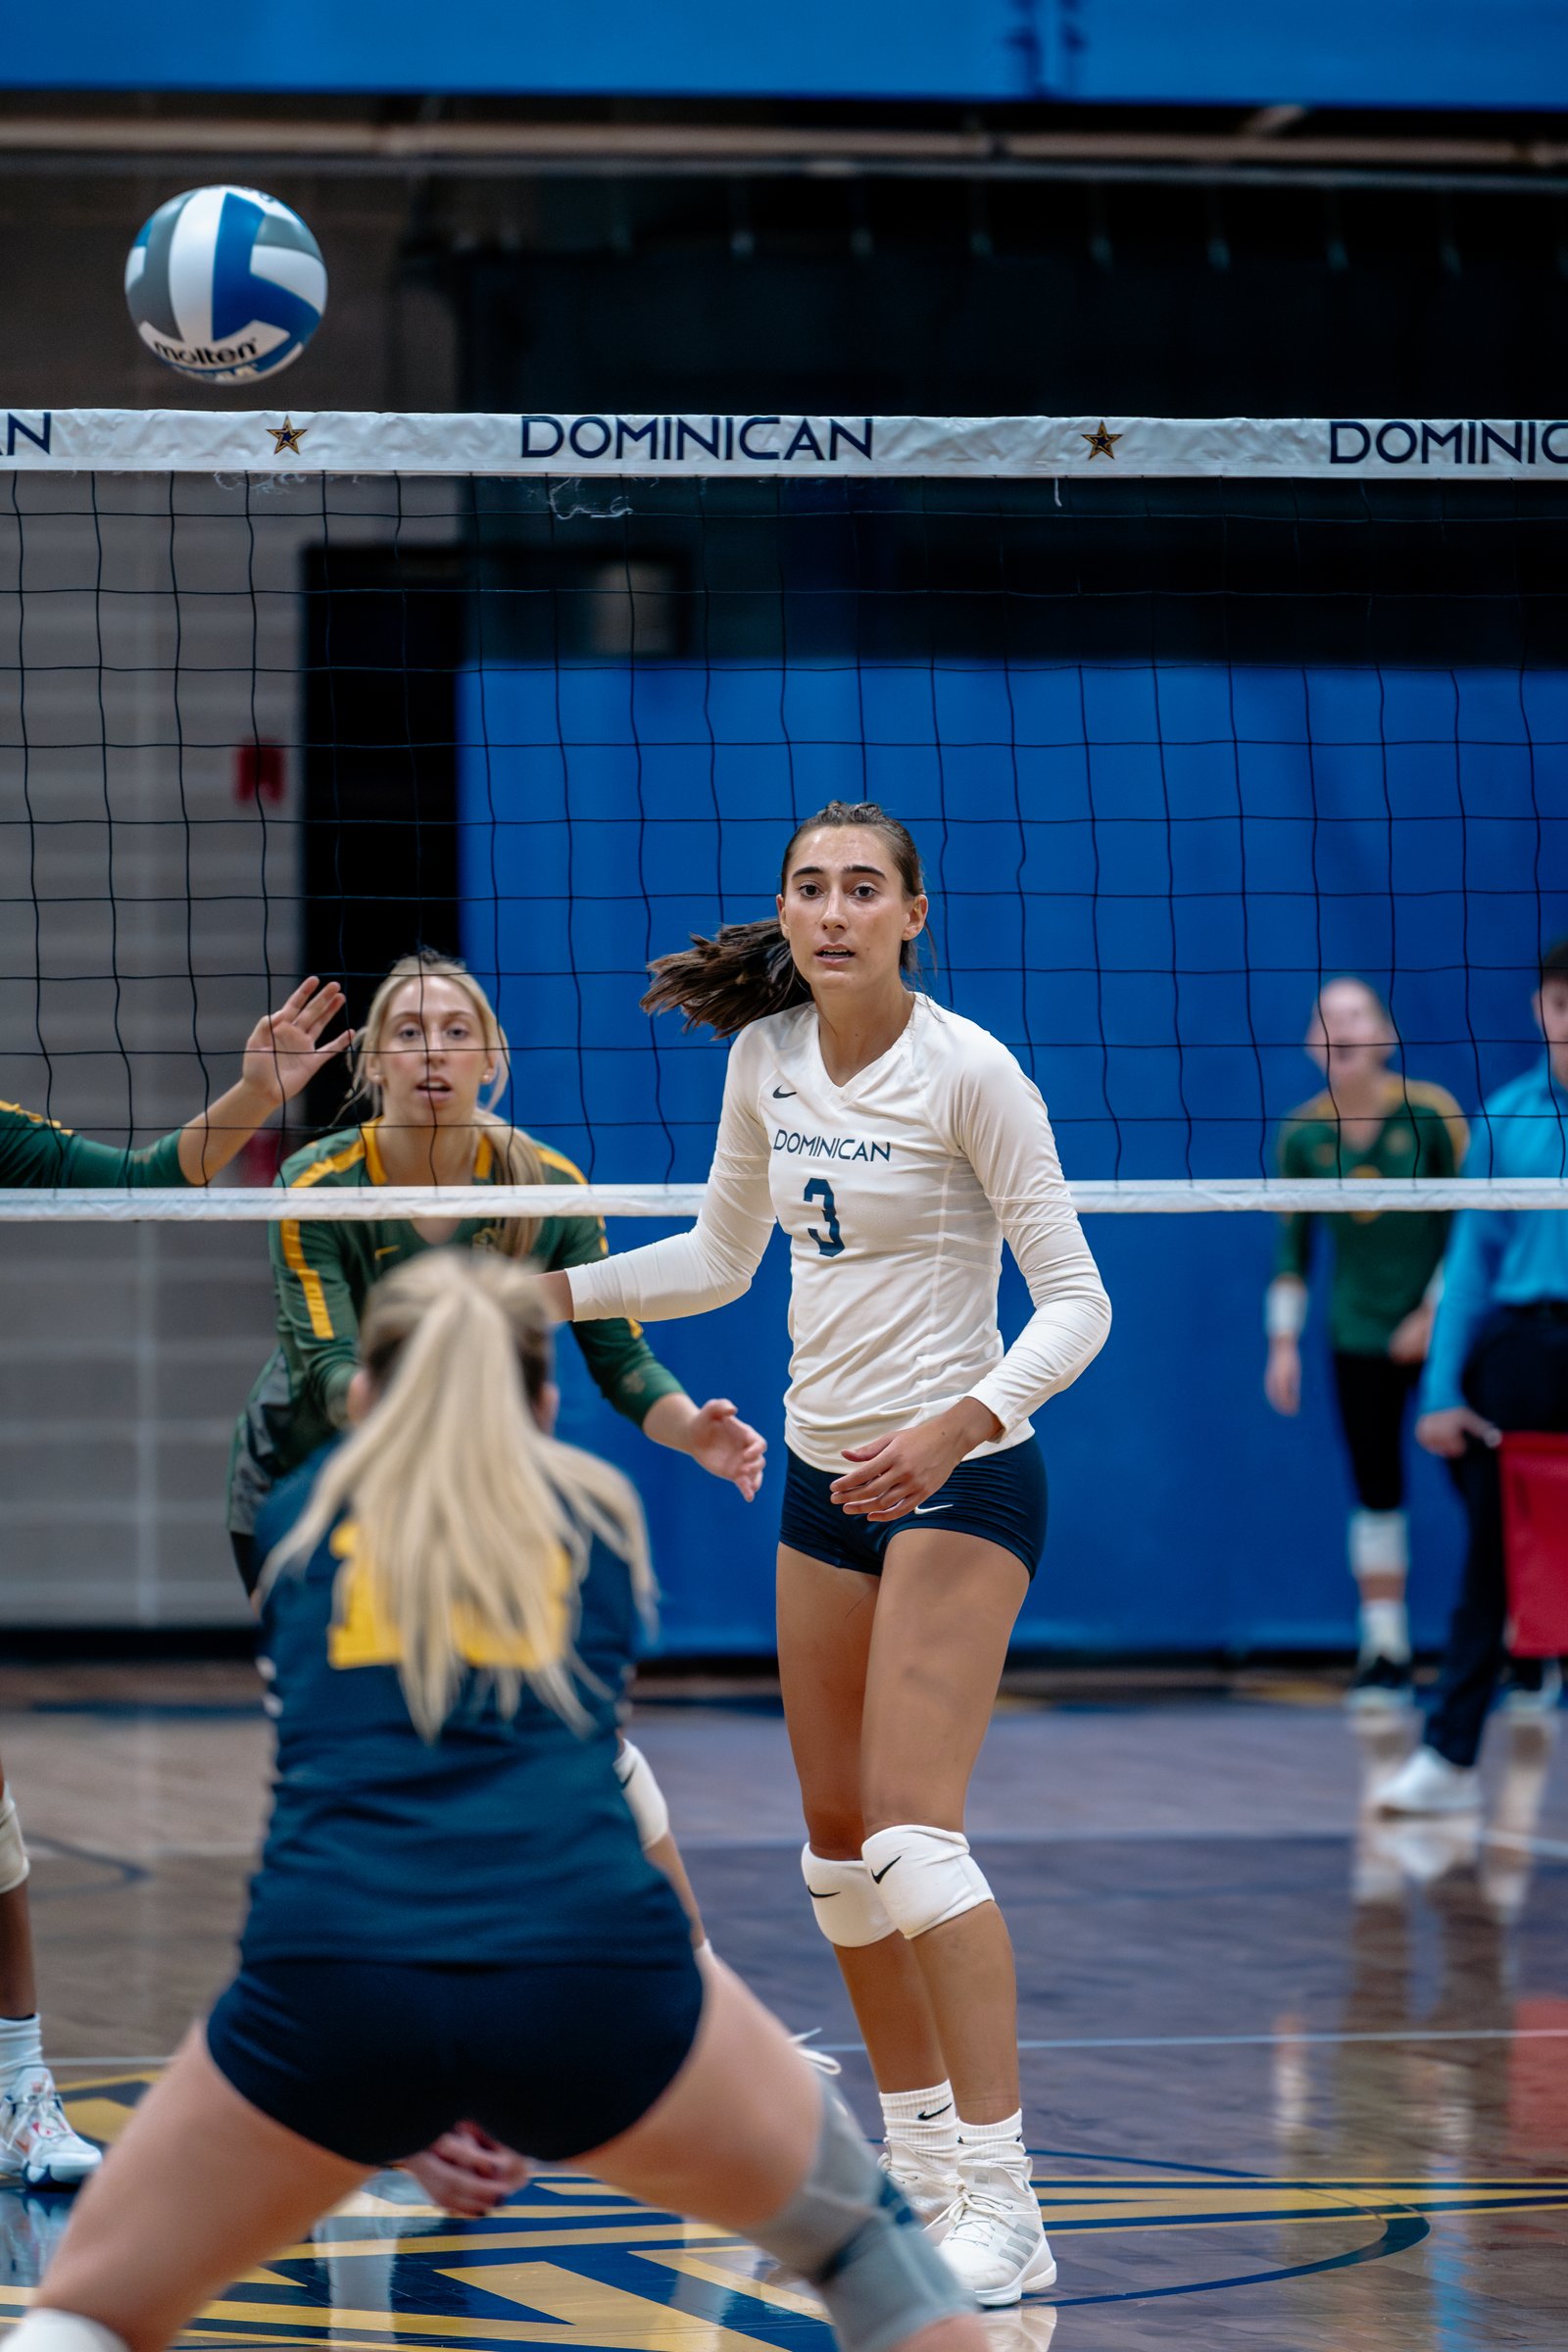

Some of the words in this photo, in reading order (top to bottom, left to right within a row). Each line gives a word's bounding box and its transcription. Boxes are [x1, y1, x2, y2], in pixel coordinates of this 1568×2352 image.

[154, 340, 257, 365] molten
[521, 416, 872, 461] DOMINICAN
[773, 1129, 891, 1161] DOMINICAN
[803, 1178, 846, 1257] 3
